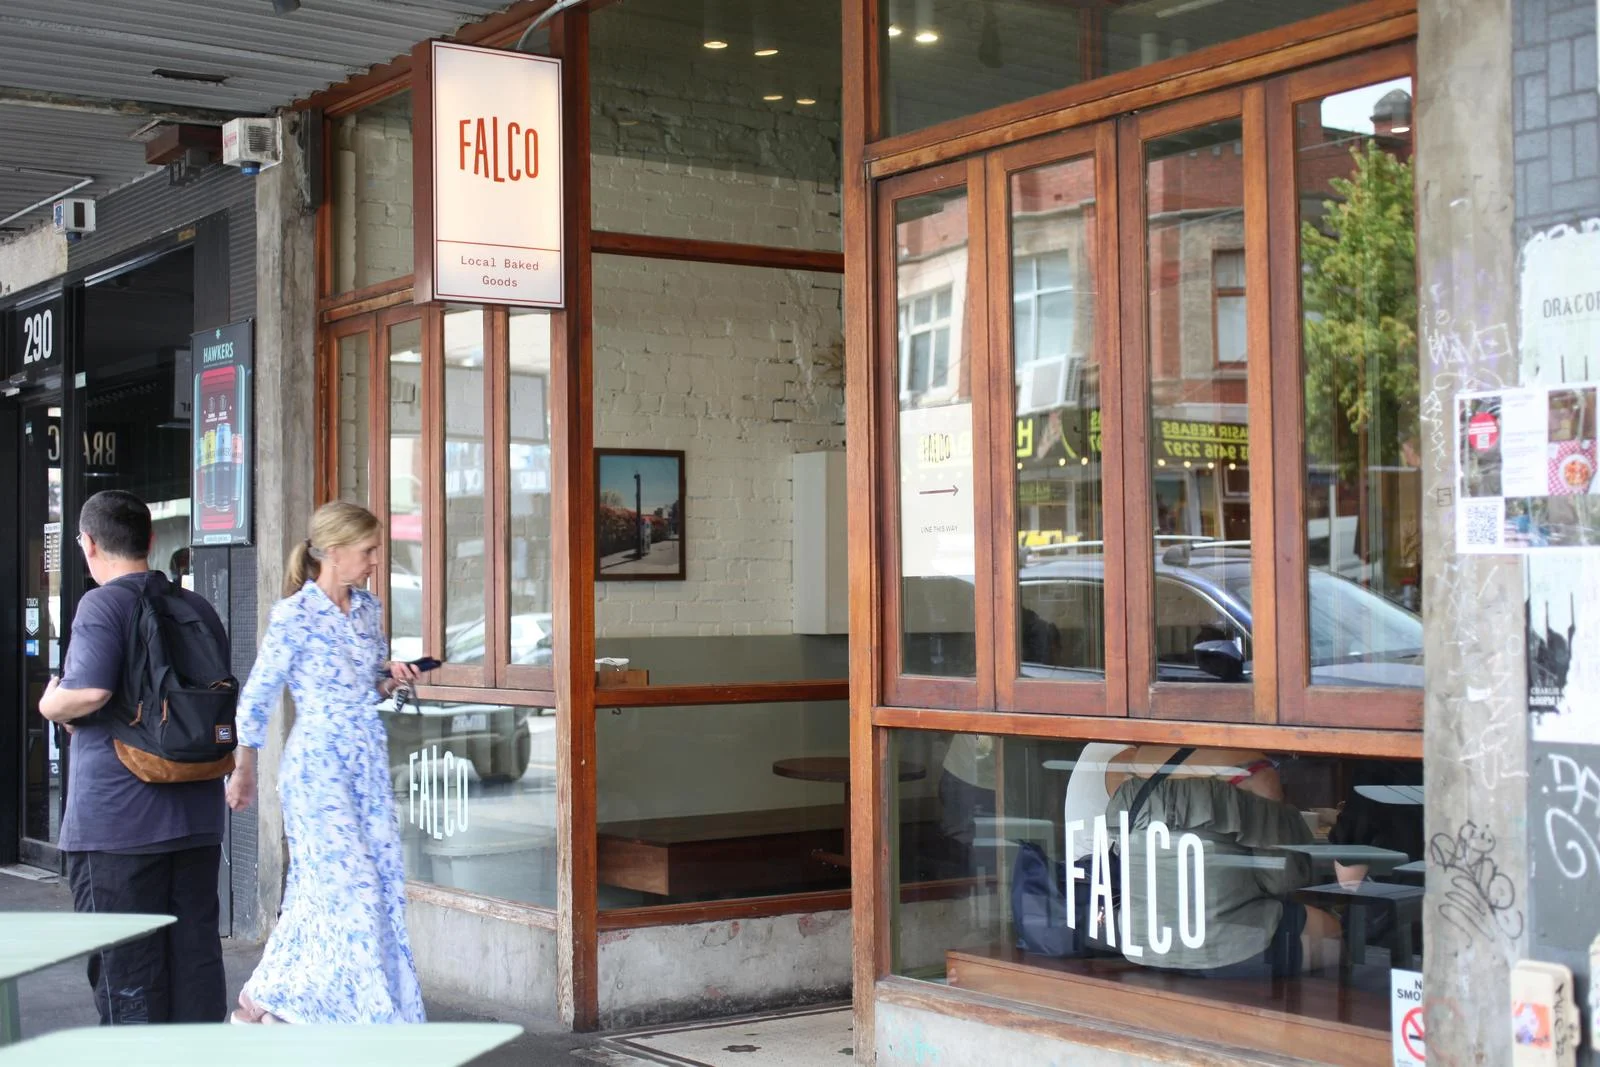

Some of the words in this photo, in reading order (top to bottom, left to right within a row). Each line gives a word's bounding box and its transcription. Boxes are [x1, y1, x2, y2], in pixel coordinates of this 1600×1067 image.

[458, 116, 539, 183] FALCO
[460, 255, 496, 269] Local
[504, 258, 540, 271] Baked
[482, 275, 518, 288] Goods
[23, 309, 53, 365] 290
[203, 341, 234, 364] HAWKERS
[923, 432, 951, 464] FALCO
[408, 744, 469, 841] FALCO
[1064, 810, 1206, 957] FALCO
